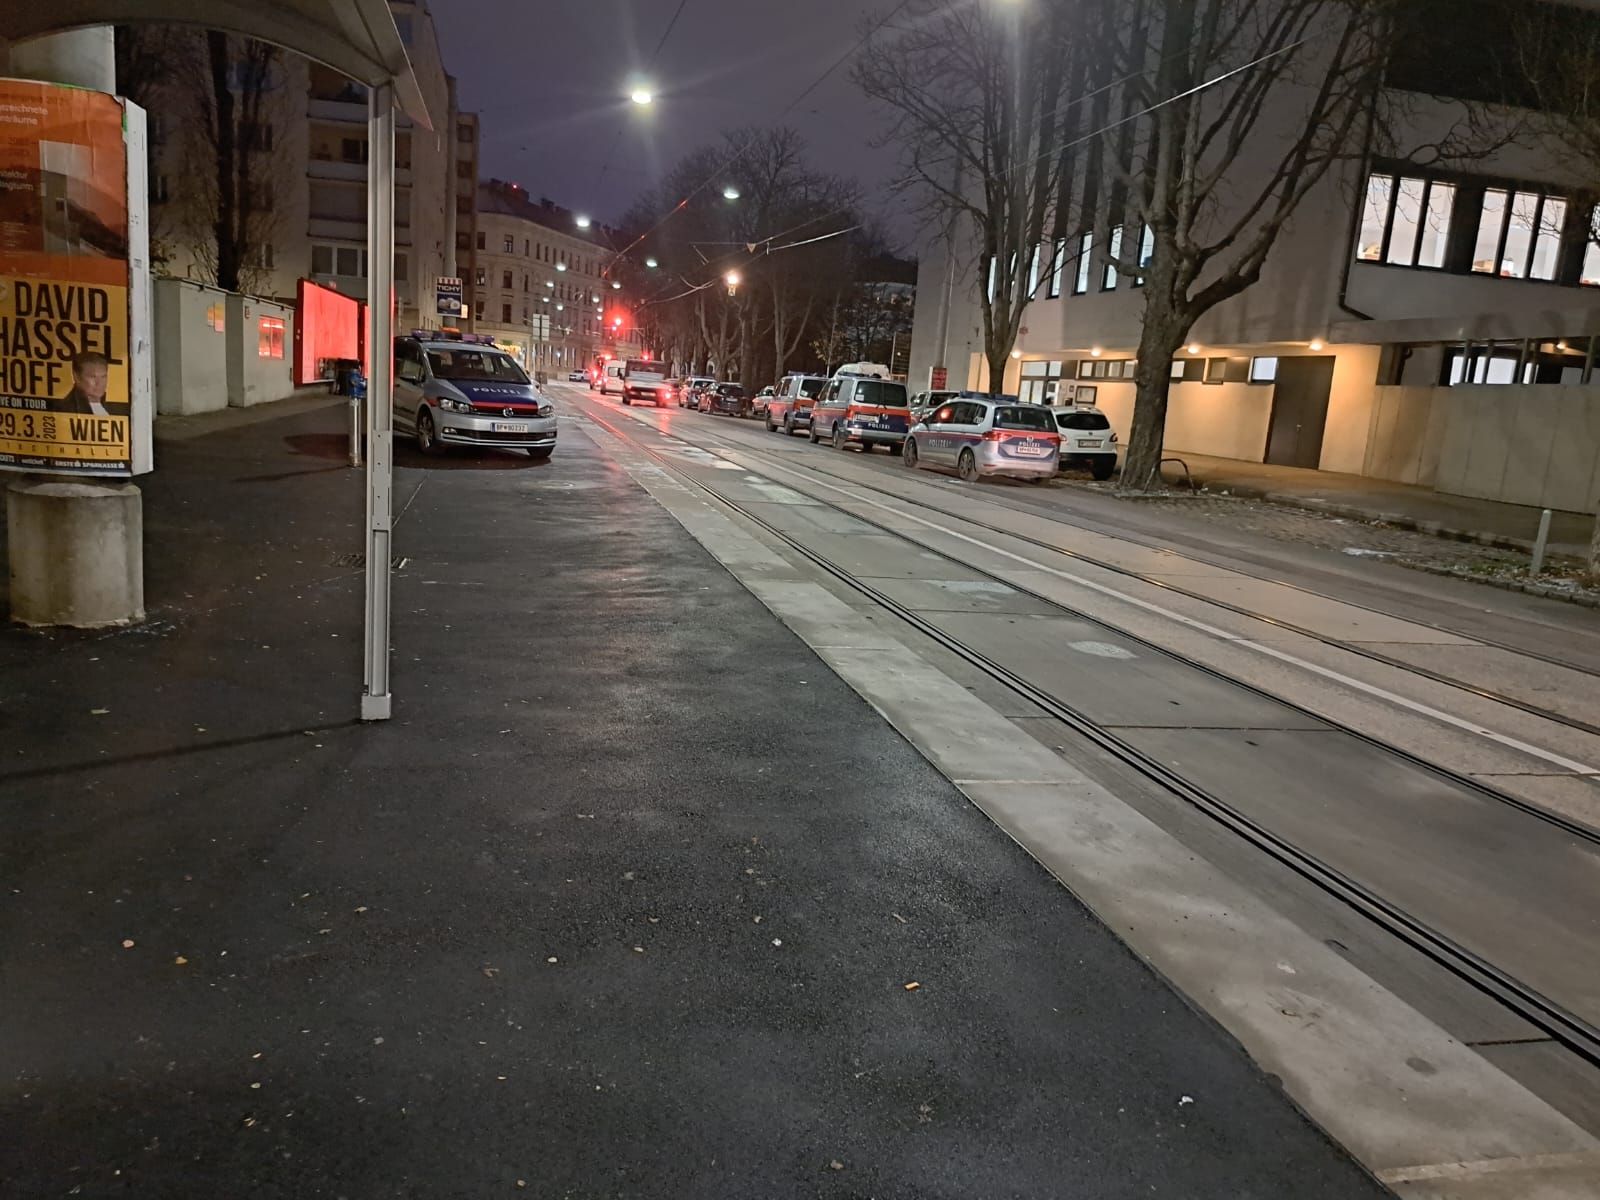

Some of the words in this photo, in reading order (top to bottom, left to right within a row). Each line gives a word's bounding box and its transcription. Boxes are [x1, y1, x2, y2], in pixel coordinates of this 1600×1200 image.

[14, 280, 108, 323] DAVID
[473, 387, 521, 395] POLIZEI
[11, 397, 22, 408] ON
[24, 398, 47, 410] TOUR
[42, 416, 56, 440] 2023
[70, 418, 124, 442] WIEN
